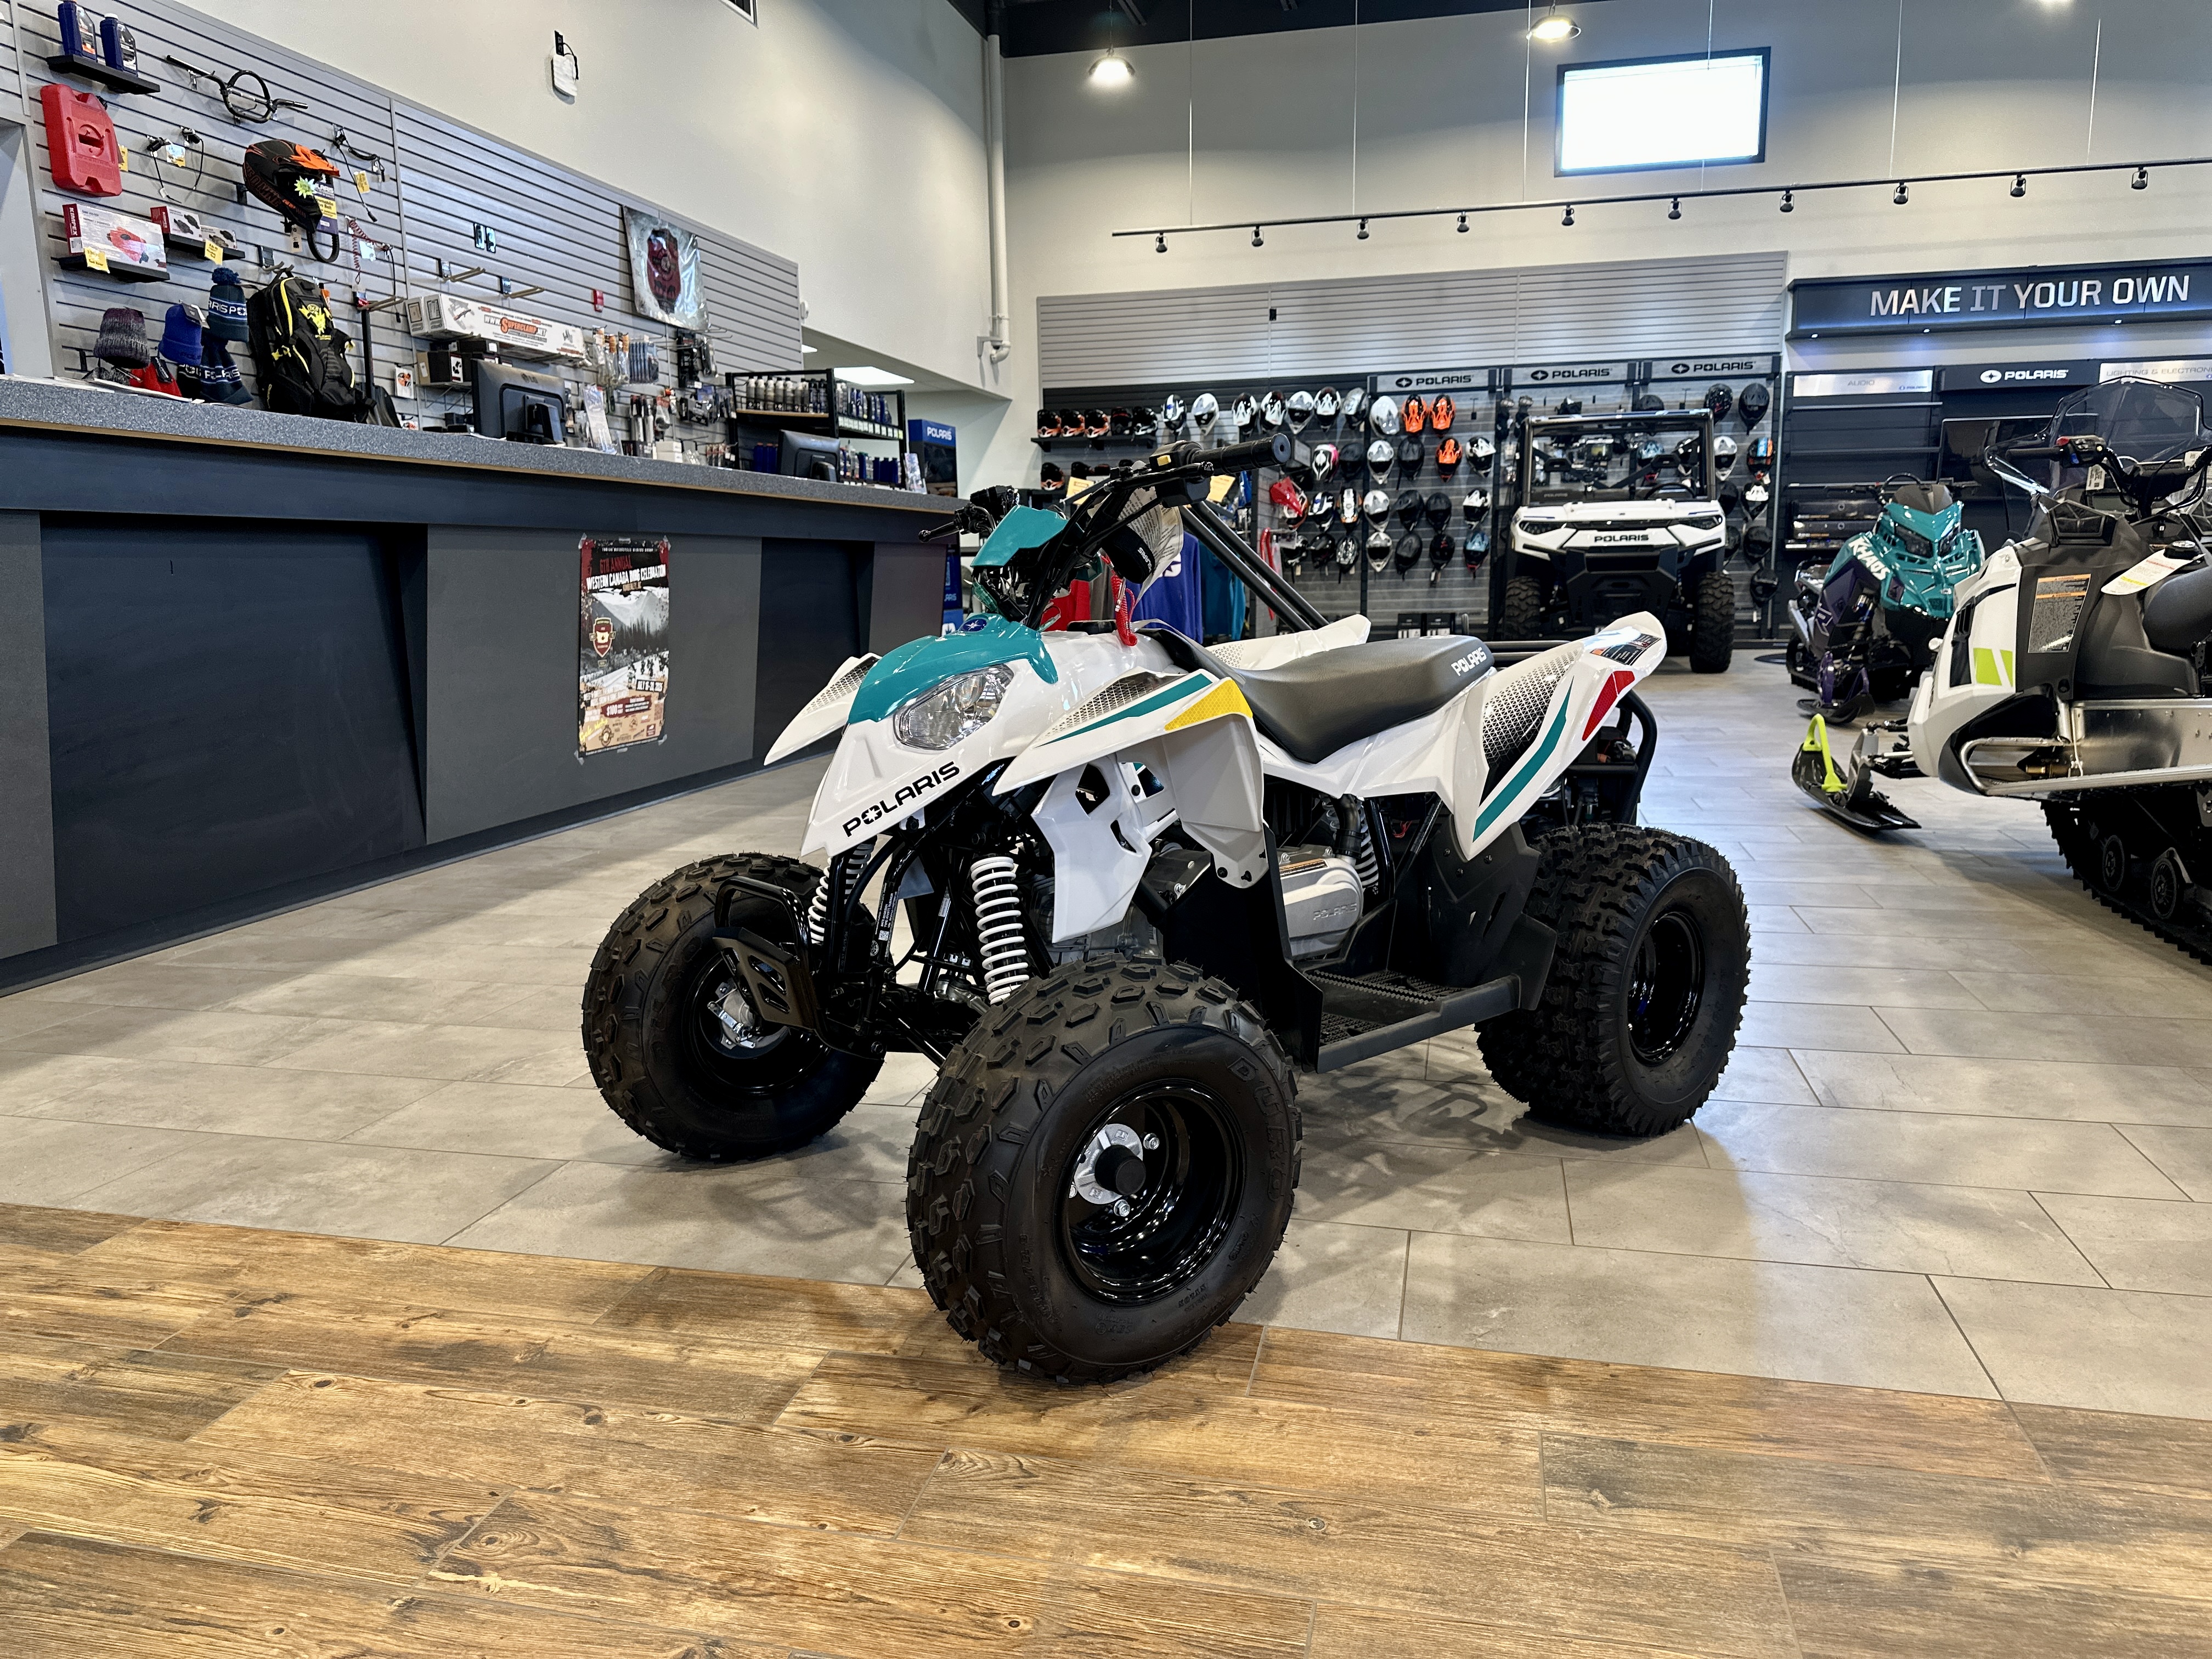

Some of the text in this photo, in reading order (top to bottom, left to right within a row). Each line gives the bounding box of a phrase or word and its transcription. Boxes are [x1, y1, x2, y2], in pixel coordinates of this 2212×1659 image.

[69, 207, 78, 236] KIMPEX
[1870, 275, 2190, 317] MAKE IT YOUR OWN
[1551, 368, 1612, 380] POLARIS
[1693, 361, 1755, 373] POLARIS
[2004, 369, 2068, 380] POLARIS
[1416, 374, 1474, 386] POLARIS
[927, 426, 952, 441] POLARIS
[1594, 534, 1649, 543] POLARIS
[600, 555, 633, 574] 6TH ANNUAL
[1848, 536, 1891, 580] KHAOS
[586, 574, 608, 590] WESTERN
[609, 570, 629, 586] CANADA
[1451, 647, 1487, 676] POLARIS
[606, 704, 618, 716] $100
[842, 761, 960, 837] POLARIS
[1313, 902, 1357, 921] POLARIS
